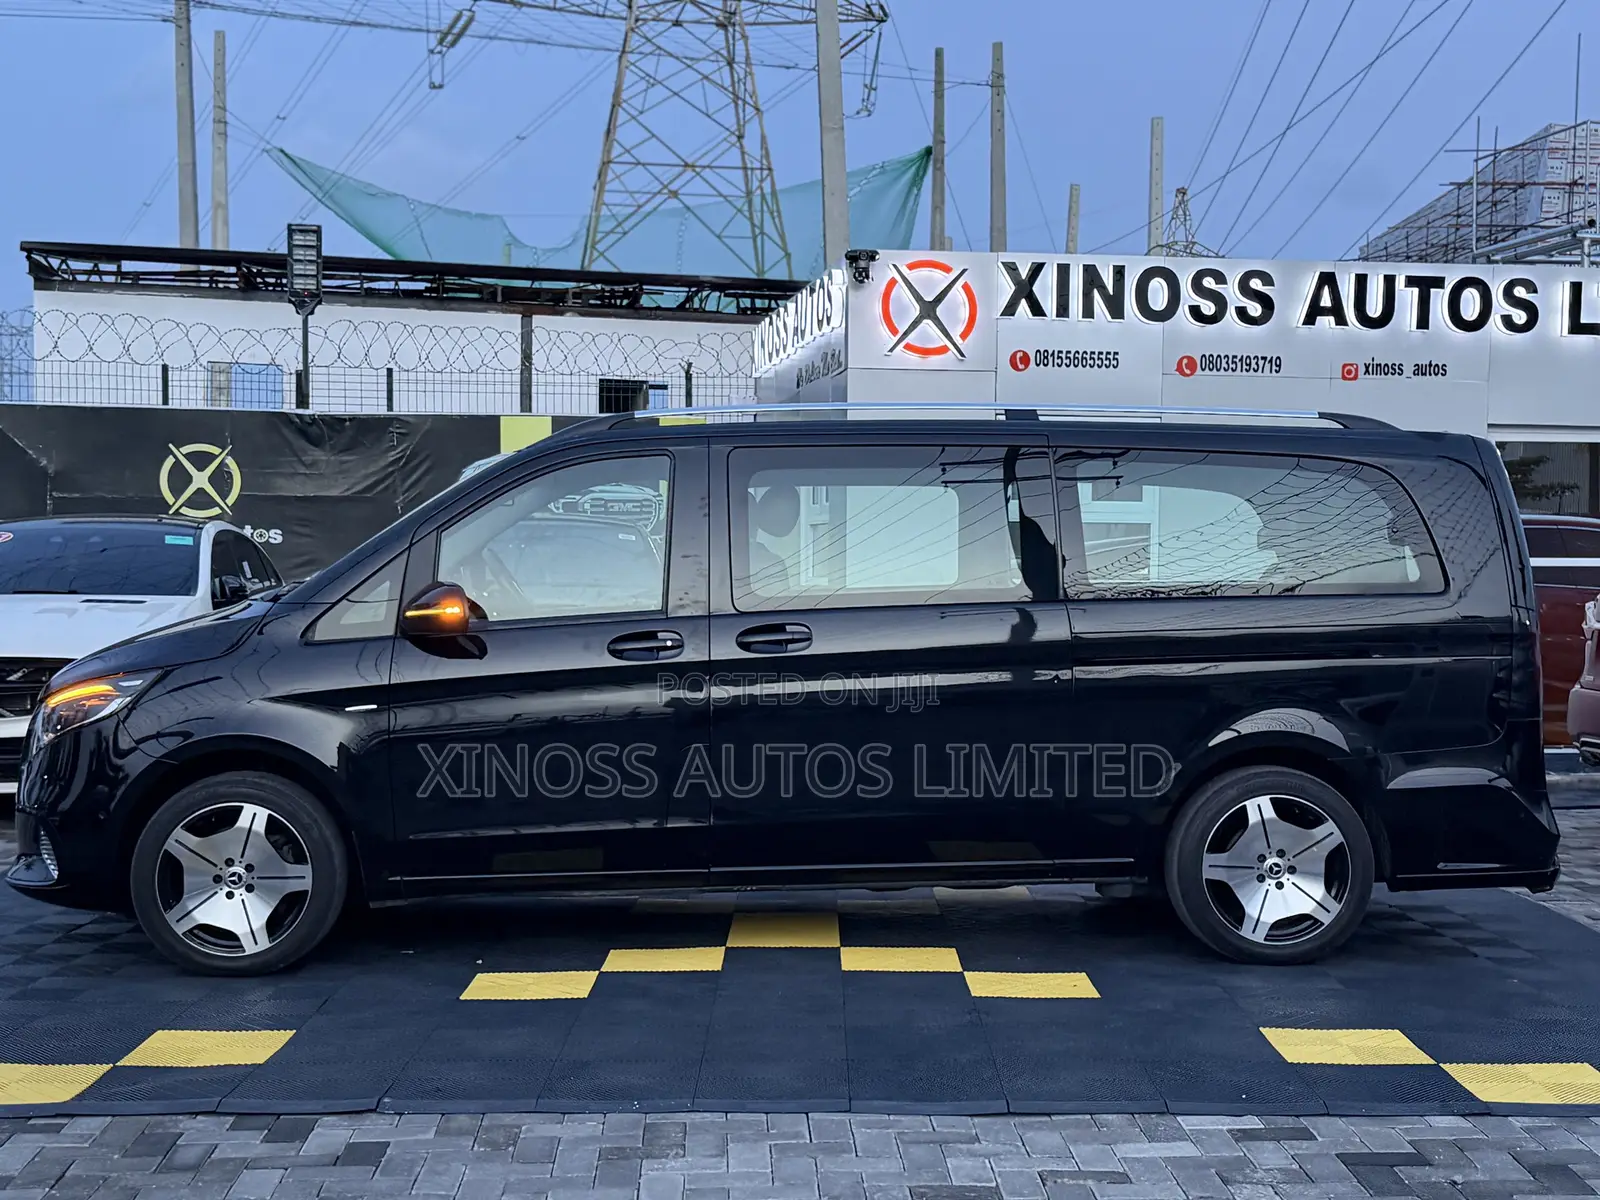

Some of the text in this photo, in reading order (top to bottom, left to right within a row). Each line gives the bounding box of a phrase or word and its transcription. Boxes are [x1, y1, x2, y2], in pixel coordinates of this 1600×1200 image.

[791, 271, 833, 348] AUTOS
[997, 260, 1276, 327] XINOSS
[1297, 270, 1540, 335] AUTOS
[1034, 349, 1120, 369] 08155665555
[1199, 353, 1282, 374] 08035193719
